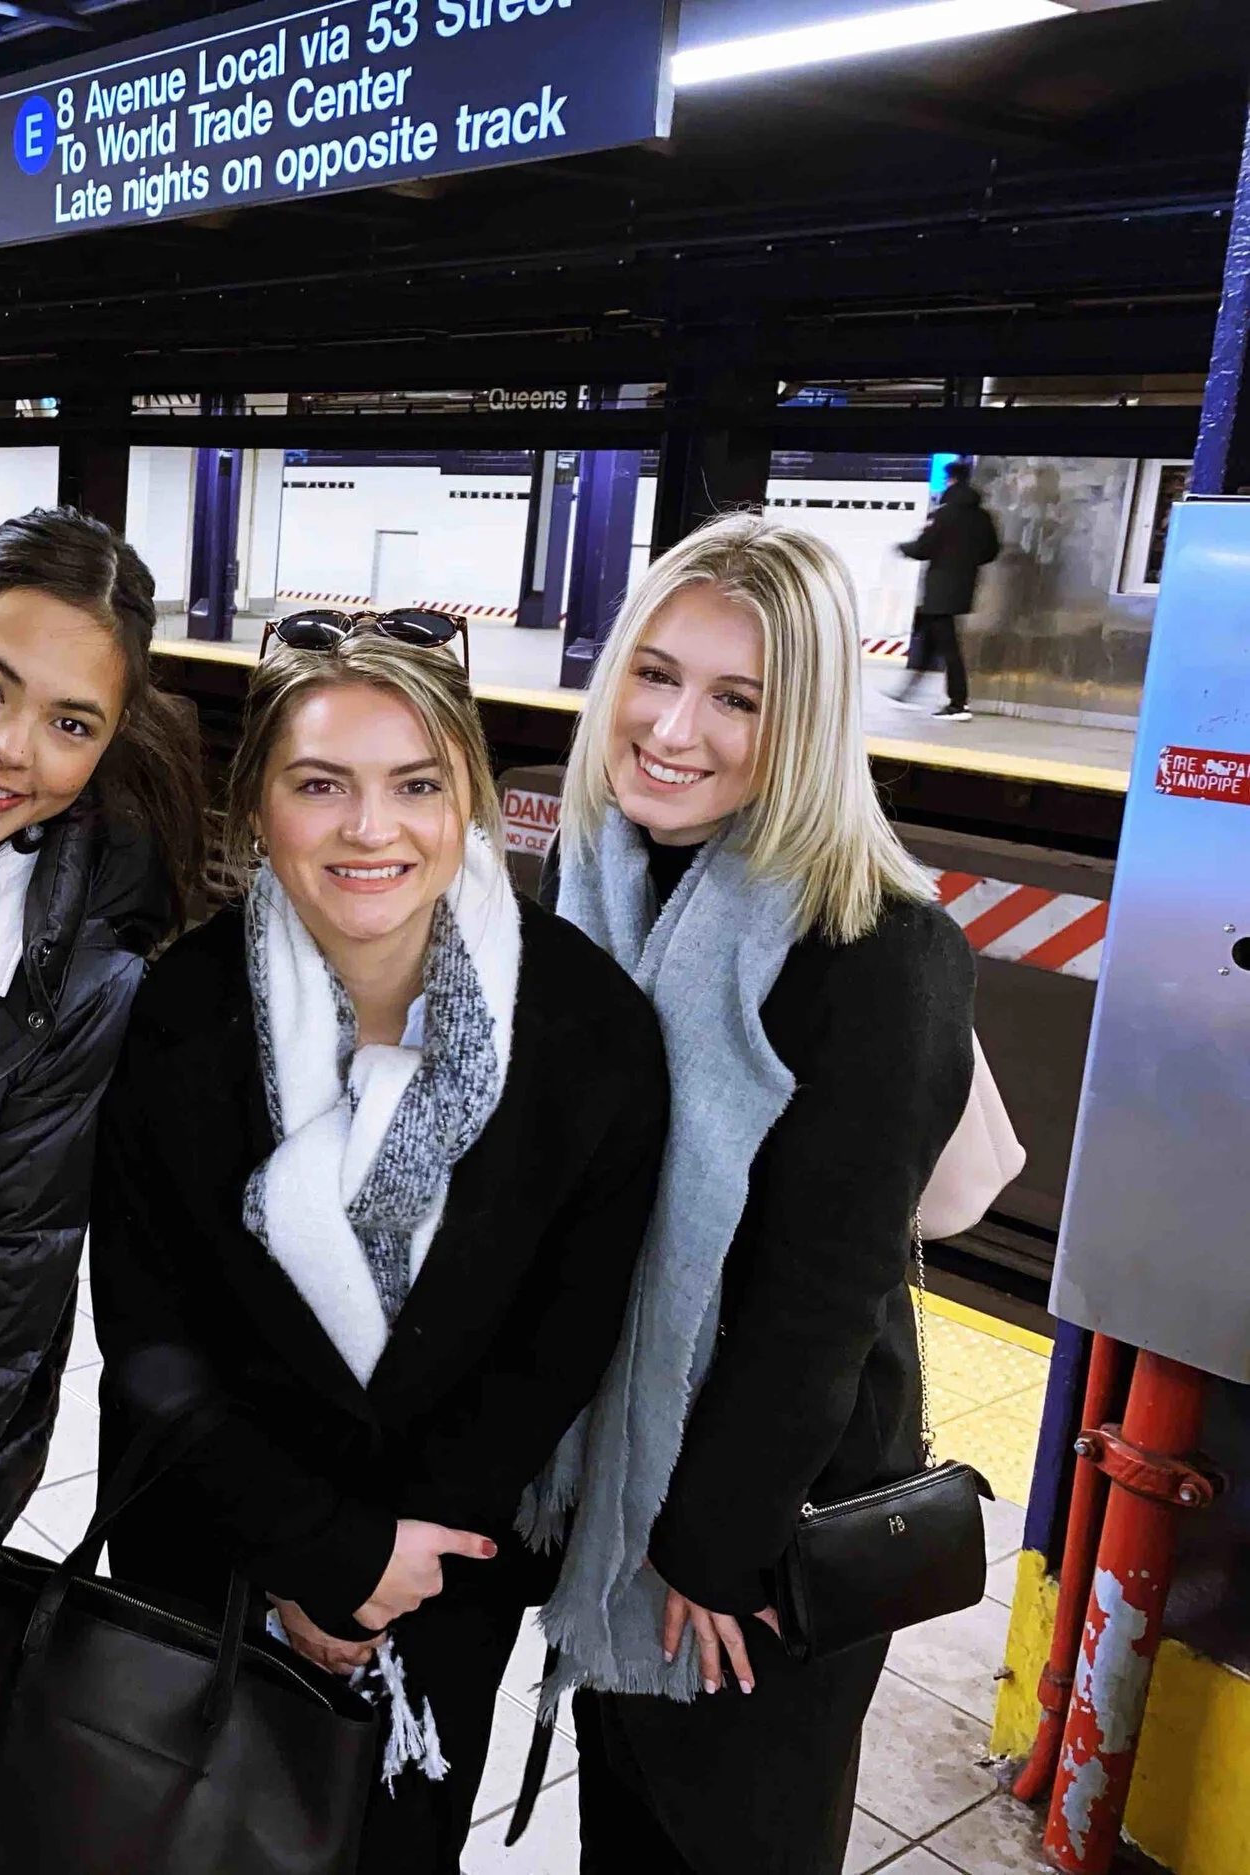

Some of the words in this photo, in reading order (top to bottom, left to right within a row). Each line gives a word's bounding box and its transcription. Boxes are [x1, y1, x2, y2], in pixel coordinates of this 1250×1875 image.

[57, 87, 75, 130] 8
[85, 68, 186, 124] Avenue
[199, 28, 286, 95] Local
[300, 17, 350, 69] via
[365, 0, 418, 53] 53
[435, 0, 572, 37] Stre
[25, 113, 43, 158] E
[57, 134, 86, 175] To
[97, 109, 176, 167] World
[188, 92, 273, 148] Trade
[287, 65, 412, 128] Center
[55, 183, 112, 224] Late
[122, 161, 209, 217] nights
[222, 154, 262, 194] on
[275, 115, 438, 191] opposite
[456, 85, 568, 153] track
[489, 388, 567, 410] Queens
[1161, 771, 1243, 794] STANDPIPE
[1165, 754, 1199, 773] FIRE
[1205, 759, 1250, 778] DEPA
[506, 832, 522, 846] NO
